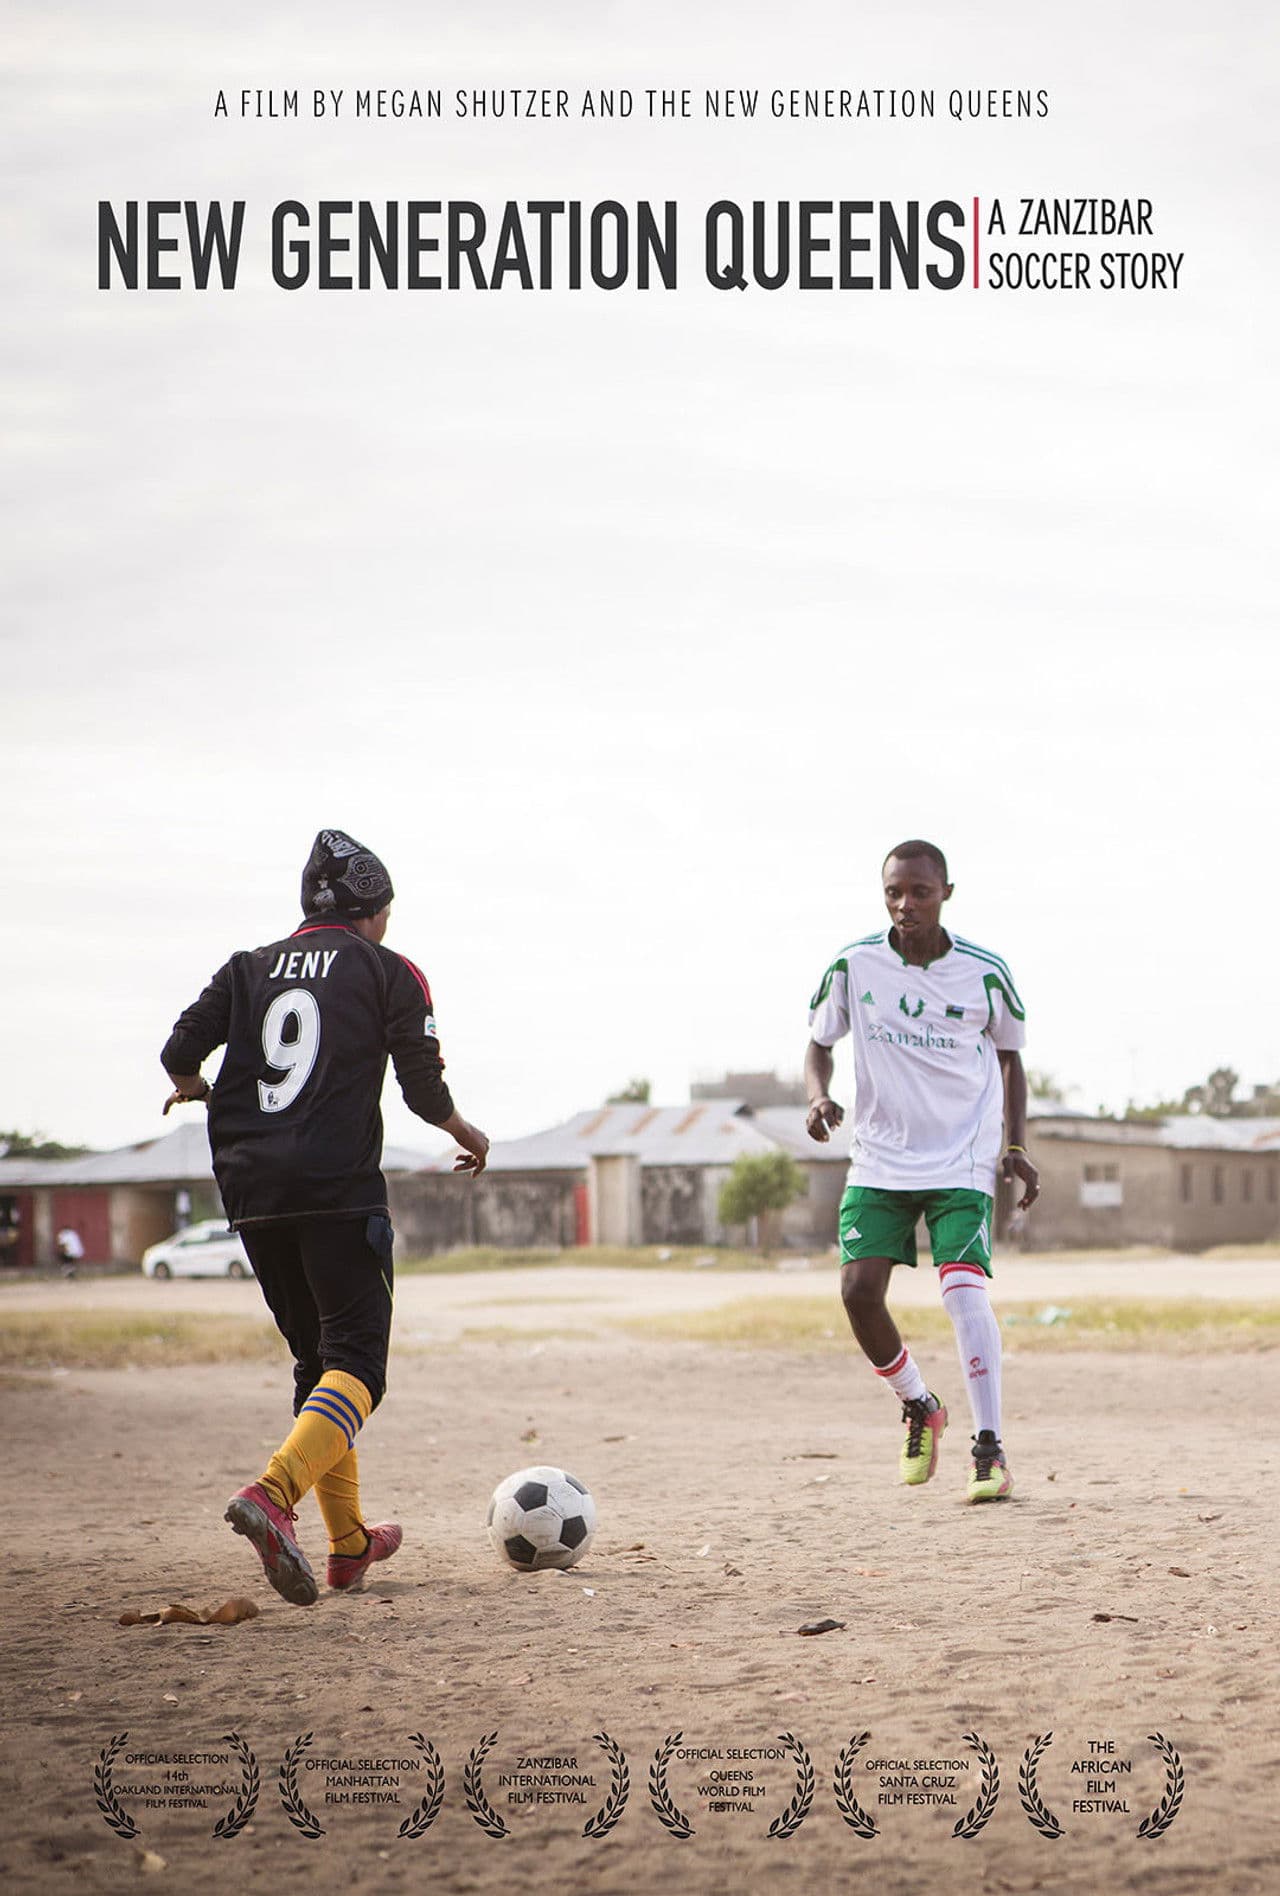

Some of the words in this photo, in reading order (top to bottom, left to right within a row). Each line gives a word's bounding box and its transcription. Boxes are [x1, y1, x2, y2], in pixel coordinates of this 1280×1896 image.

[269, 950, 338, 979] JENY
[257, 988, 321, 1113] 9
[868, 1024, 960, 1050] Zanzibar
